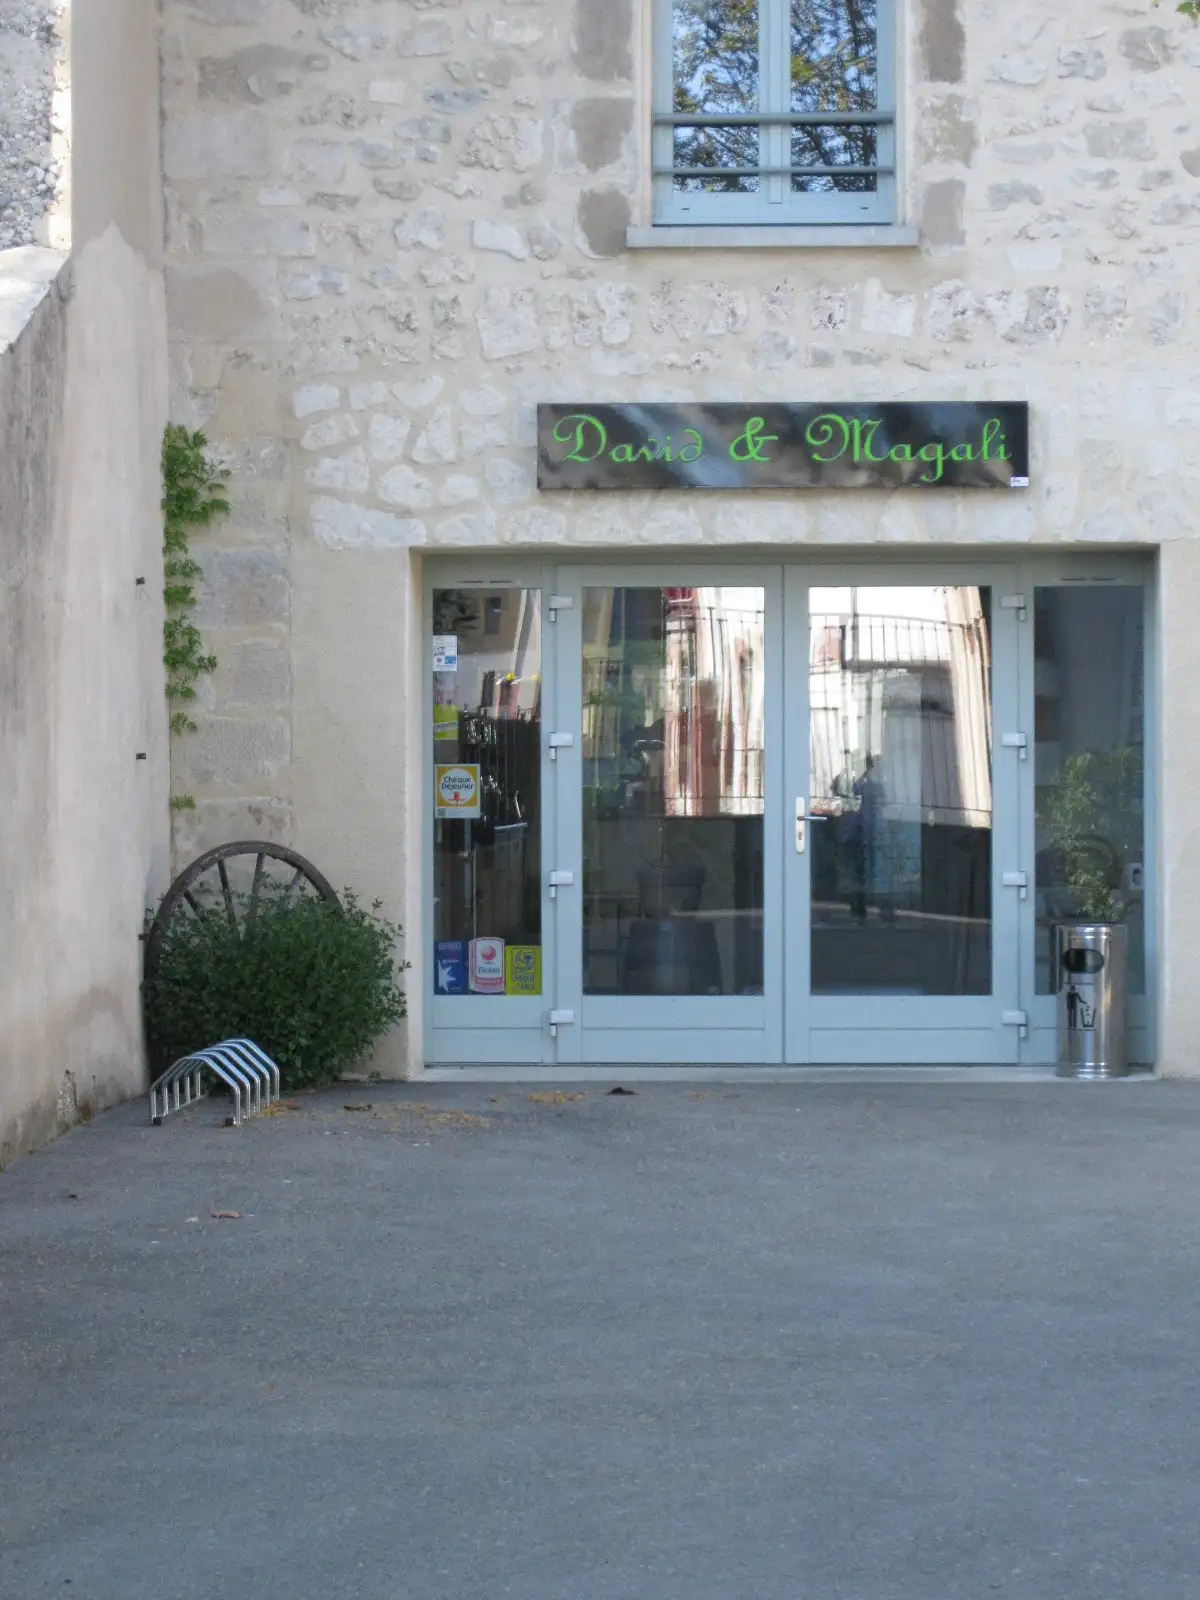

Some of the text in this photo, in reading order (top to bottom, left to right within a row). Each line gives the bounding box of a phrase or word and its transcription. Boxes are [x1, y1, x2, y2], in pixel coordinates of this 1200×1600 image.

[551, 413, 1012, 481] David & Magali
